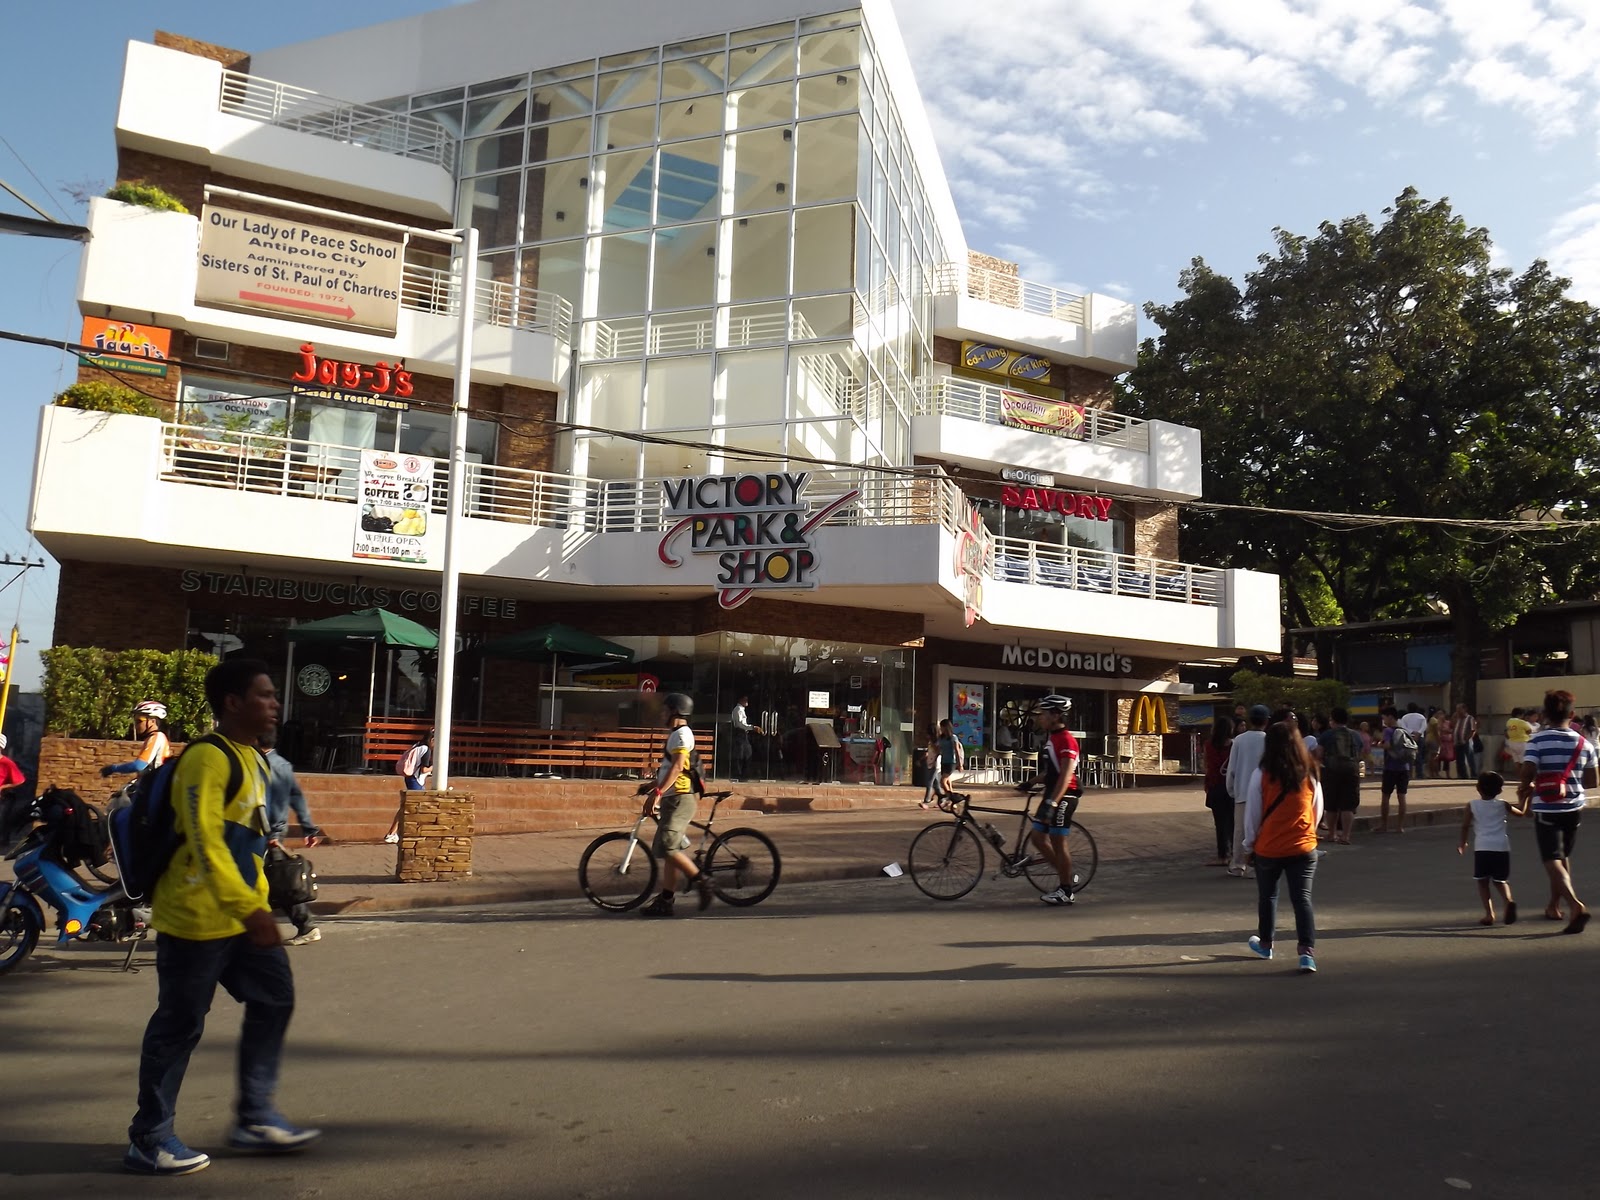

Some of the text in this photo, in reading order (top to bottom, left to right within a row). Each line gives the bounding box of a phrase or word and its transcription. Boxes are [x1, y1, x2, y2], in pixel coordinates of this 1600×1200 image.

[211, 212, 396, 260] Our Lady of Peace School
[247, 253, 359, 280] Administered By:
[249, 237, 367, 268] Antipolo City
[202, 254, 398, 300] Sisters of St. Paul of Chartres
[256, 282, 344, 302] FOUNDED: 1972
[966, 348, 1006, 366] cd-r king
[1012, 358, 1051, 376] cd-r king
[334, 392, 342, 400] &
[364, 488, 400, 500] COFFEE
[663, 472, 808, 510] VICTORY
[1002, 485, 1112, 522] SAVORY
[717, 550, 814, 584] SHOP
[180, 569, 516, 618] STARBUCKS COFEE
[1001, 644, 1132, 673] McDonald's
